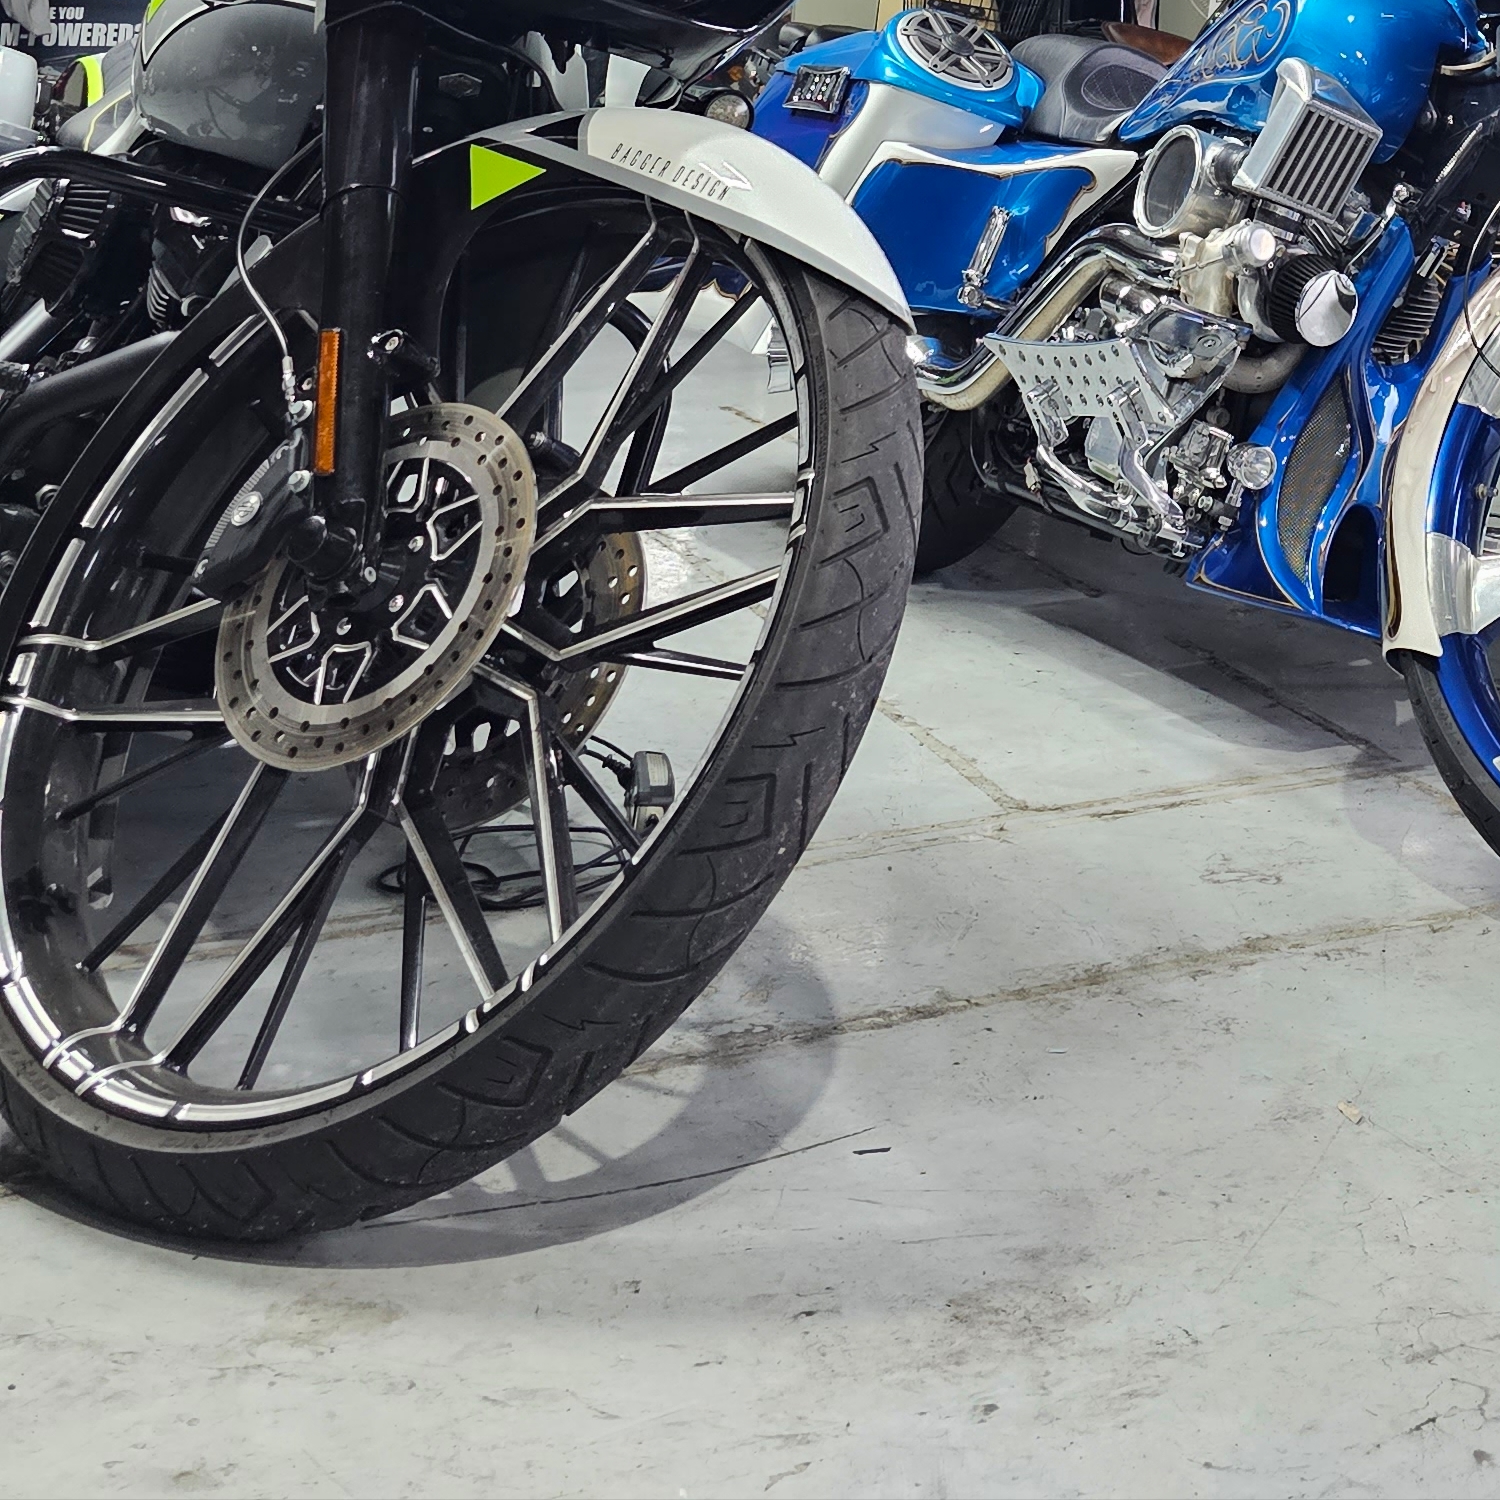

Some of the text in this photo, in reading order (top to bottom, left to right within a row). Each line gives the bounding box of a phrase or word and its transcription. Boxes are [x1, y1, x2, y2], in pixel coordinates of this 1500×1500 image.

[58, 6, 85, 20] YOU
[610, 143, 731, 201] BAGGER DESIGN
